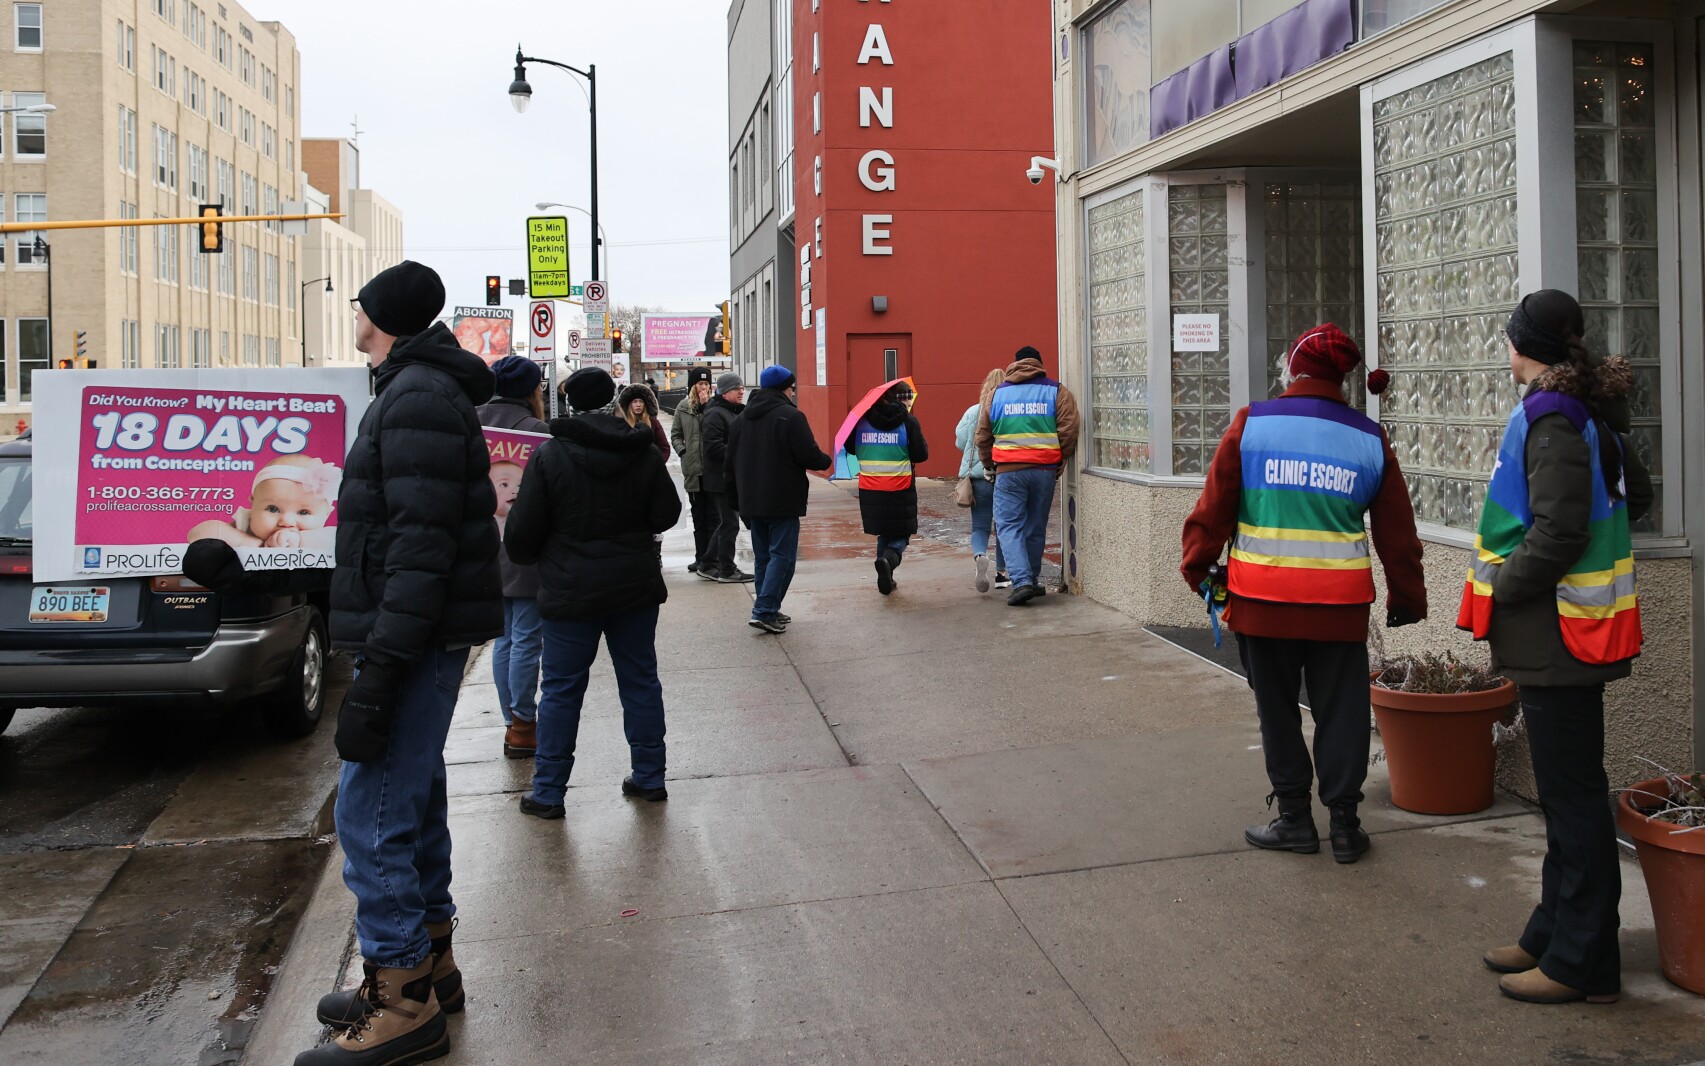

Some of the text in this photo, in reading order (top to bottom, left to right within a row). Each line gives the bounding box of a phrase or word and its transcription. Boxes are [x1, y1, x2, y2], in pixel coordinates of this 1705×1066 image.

[856, 0, 896, 256] ANGE
[534, 224, 561, 232] 15 Min
[531, 234, 565, 242] Takeout
[532, 244, 565, 254] Parking
[538, 255, 559, 265] Only
[570, 286, 580, 295] St
[455, 307, 511, 319] ABORTION
[89, 394, 336, 414] Did You Know? My Heart Beat
[1004, 402, 1048, 415] CLINIC ESCORT
[92, 410, 312, 454] 18 DAYS
[861, 432, 899, 444] CLINIC ESCORT
[90, 453, 255, 474] from Conception
[1265, 458, 1358, 494] CLINIC ESCORT
[87, 486, 235, 500] 1-800-366-7773
[86, 500, 234, 514] prolifeacrossamerica.org
[38, 596, 101, 612] 890 BEE
